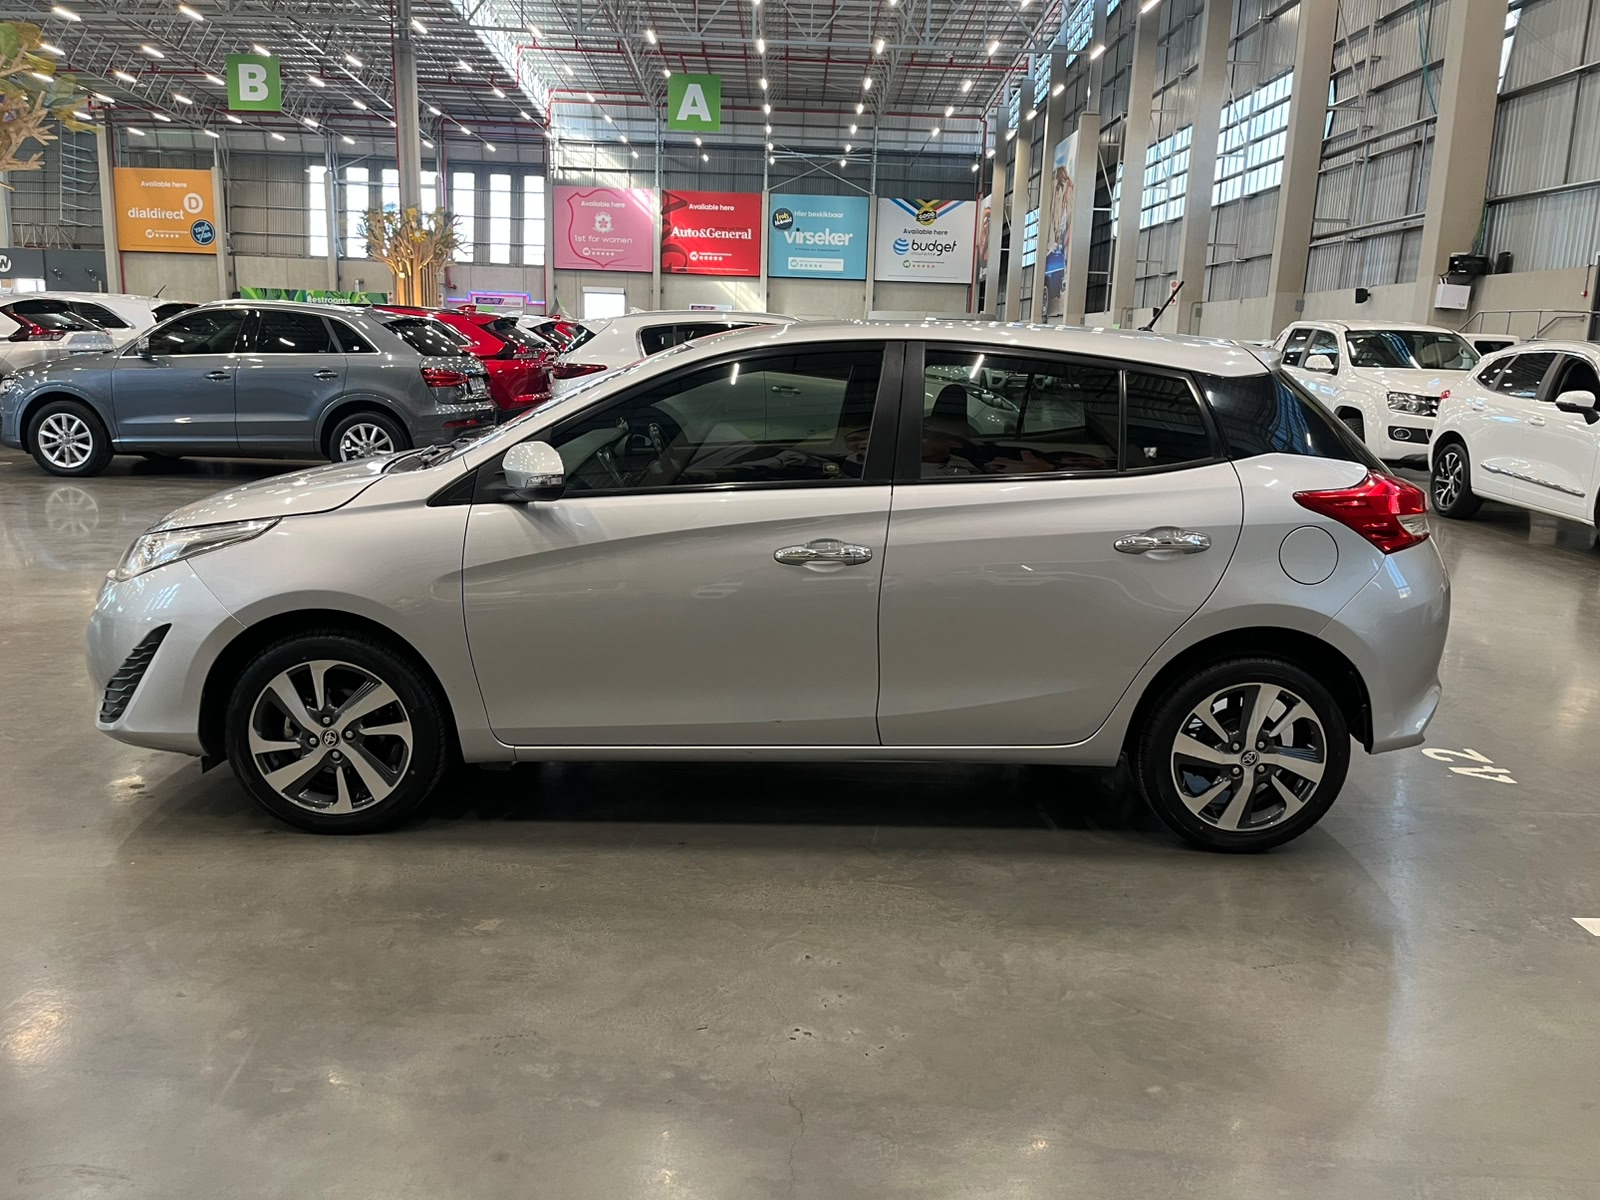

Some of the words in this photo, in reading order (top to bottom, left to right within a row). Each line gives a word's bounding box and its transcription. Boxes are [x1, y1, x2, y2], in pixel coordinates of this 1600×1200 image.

[238, 64, 269, 102] B
[676, 84, 712, 121] A
[140, 180, 171, 188] Available
[580, 200, 610, 208] Available
[610, 201, 626, 209] here
[688, 203, 719, 211] Available
[127, 207, 185, 220] dialdirect
[808, 211, 844, 219] beskikbaar
[574, 234, 586, 242] 1st
[602, 236, 633, 244] women
[671, 226, 752, 240] Auto&General
[783, 227, 853, 246] virseker
[911, 239, 957, 256] budget
[307, 294, 351, 305] Restrooms
